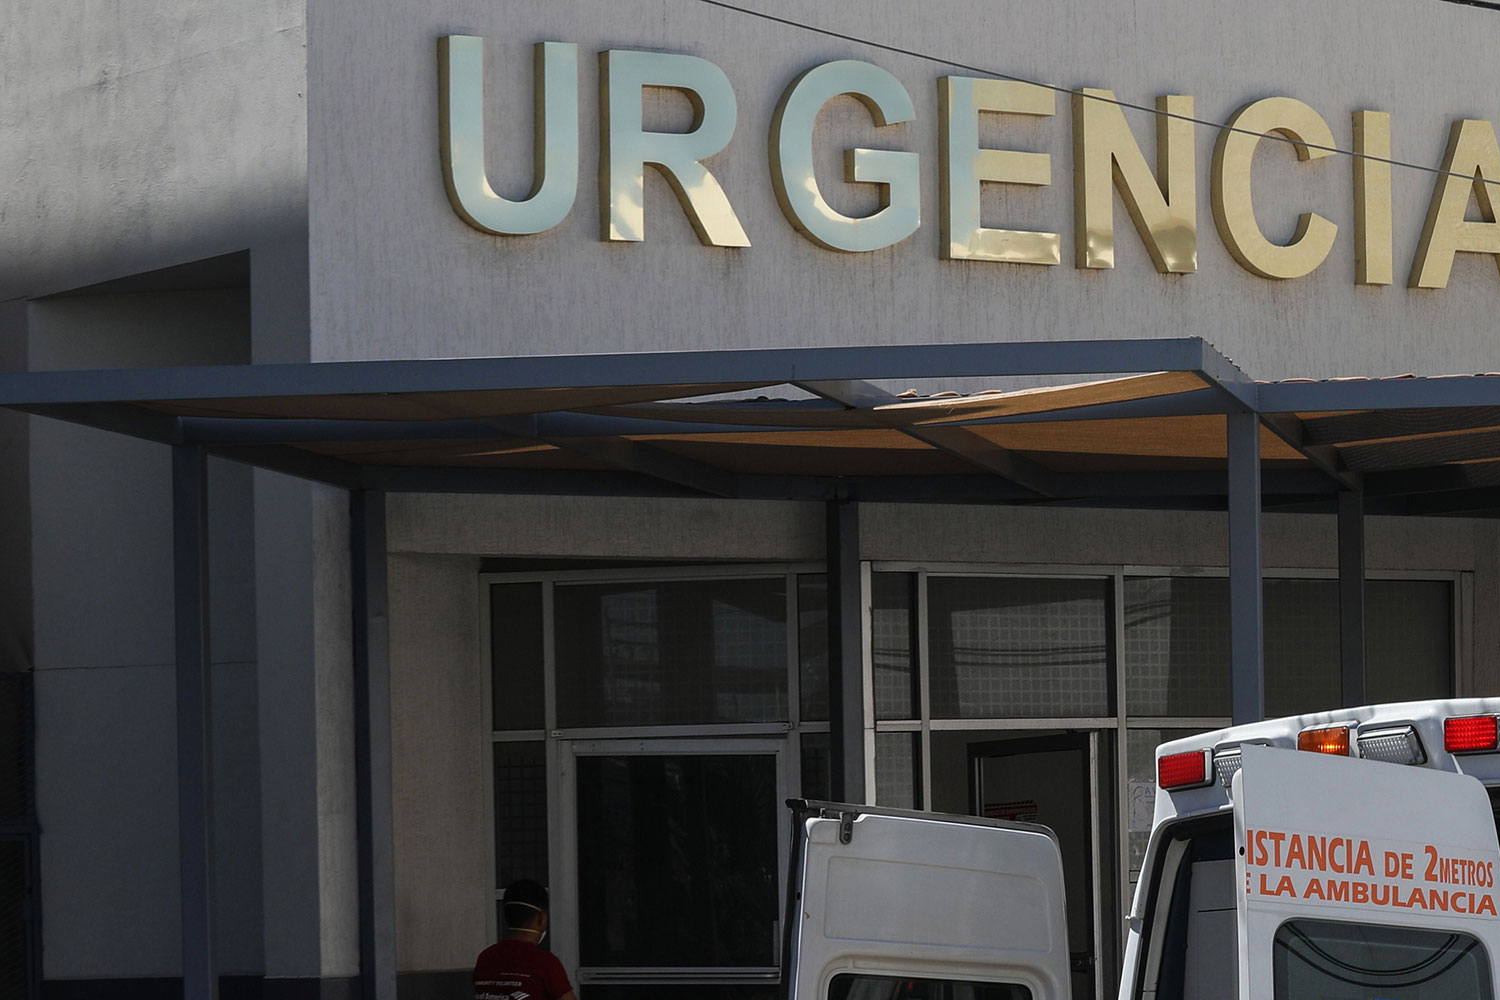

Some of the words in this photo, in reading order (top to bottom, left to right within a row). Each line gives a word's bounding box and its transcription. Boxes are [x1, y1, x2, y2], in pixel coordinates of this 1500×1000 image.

[1384, 851, 1414, 880] DE
[1260, 873, 1297, 898] LA
[1302, 877, 1498, 917] AMBULANCIA
